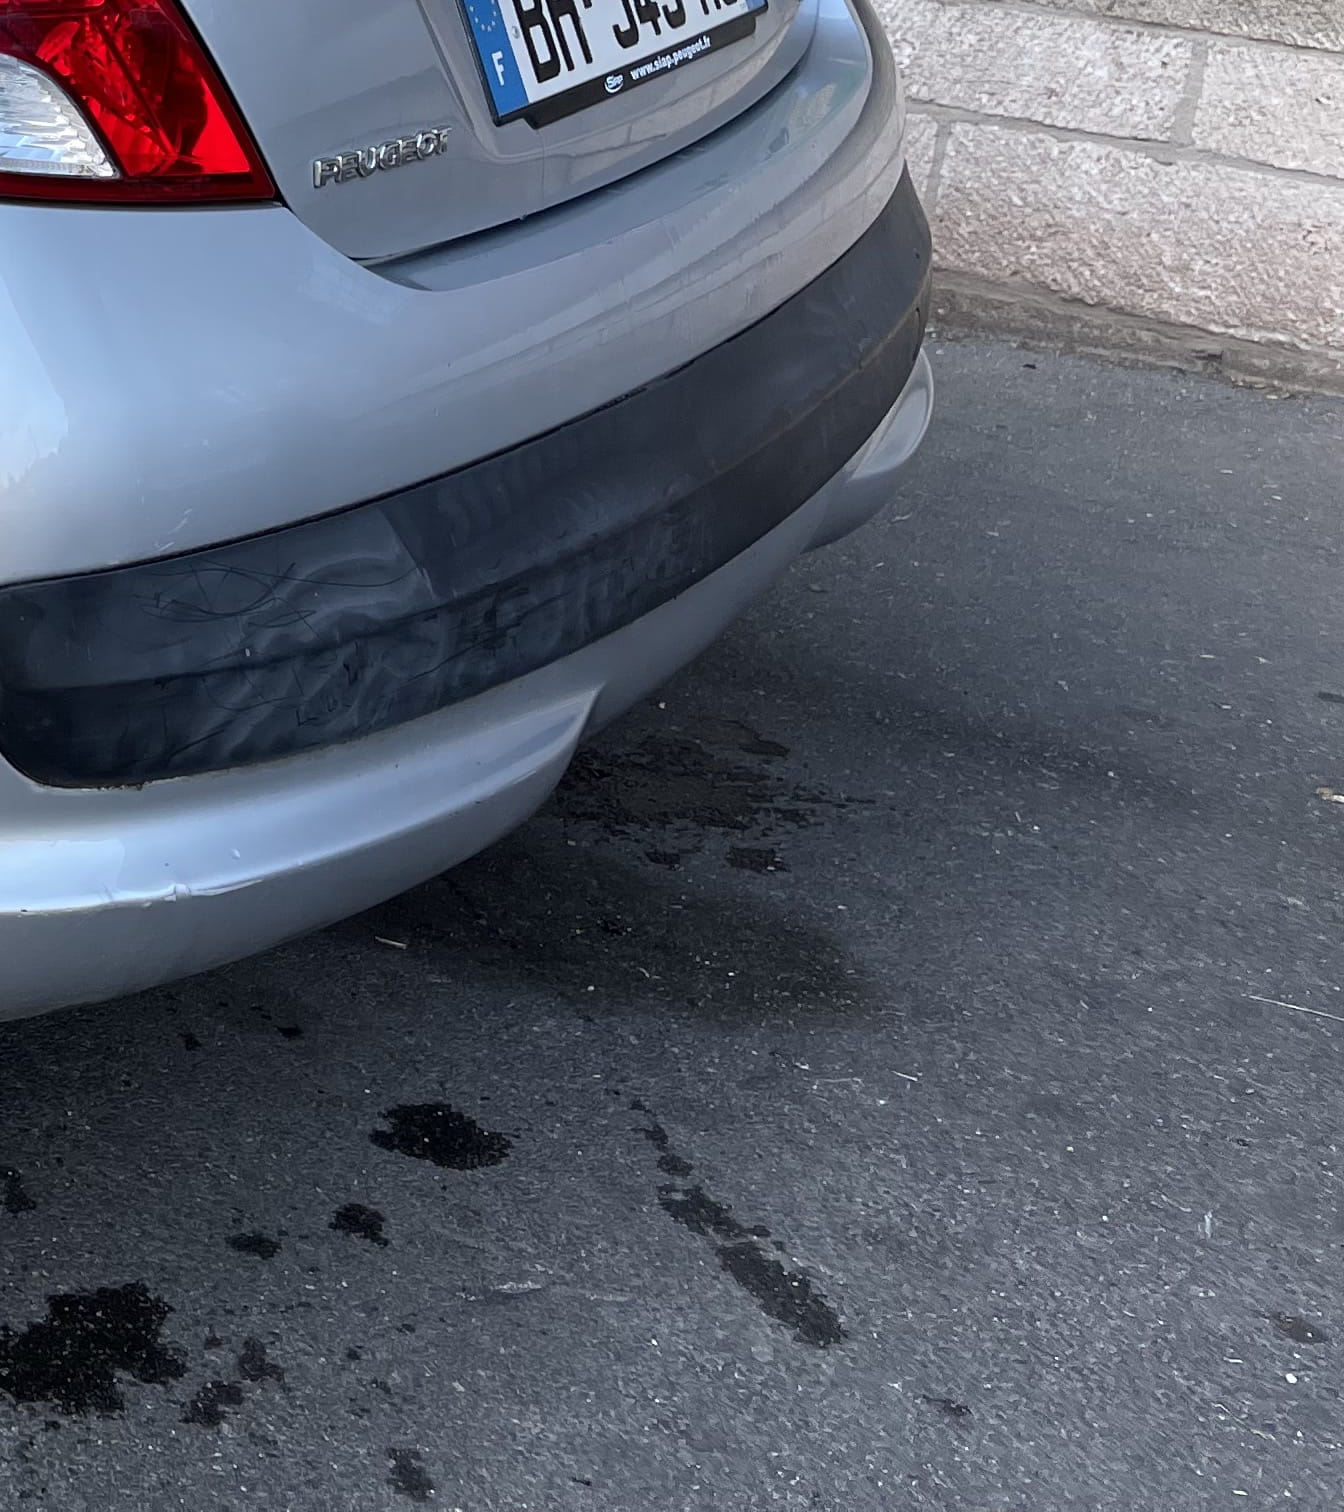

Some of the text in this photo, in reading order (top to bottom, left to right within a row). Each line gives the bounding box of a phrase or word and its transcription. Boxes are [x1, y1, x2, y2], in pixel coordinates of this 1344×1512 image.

[491, 51, 505, 86] F
[630, 35, 712, 81] www.siap.peugeot.fr
[313, 125, 452, 188] PEUGEOT
